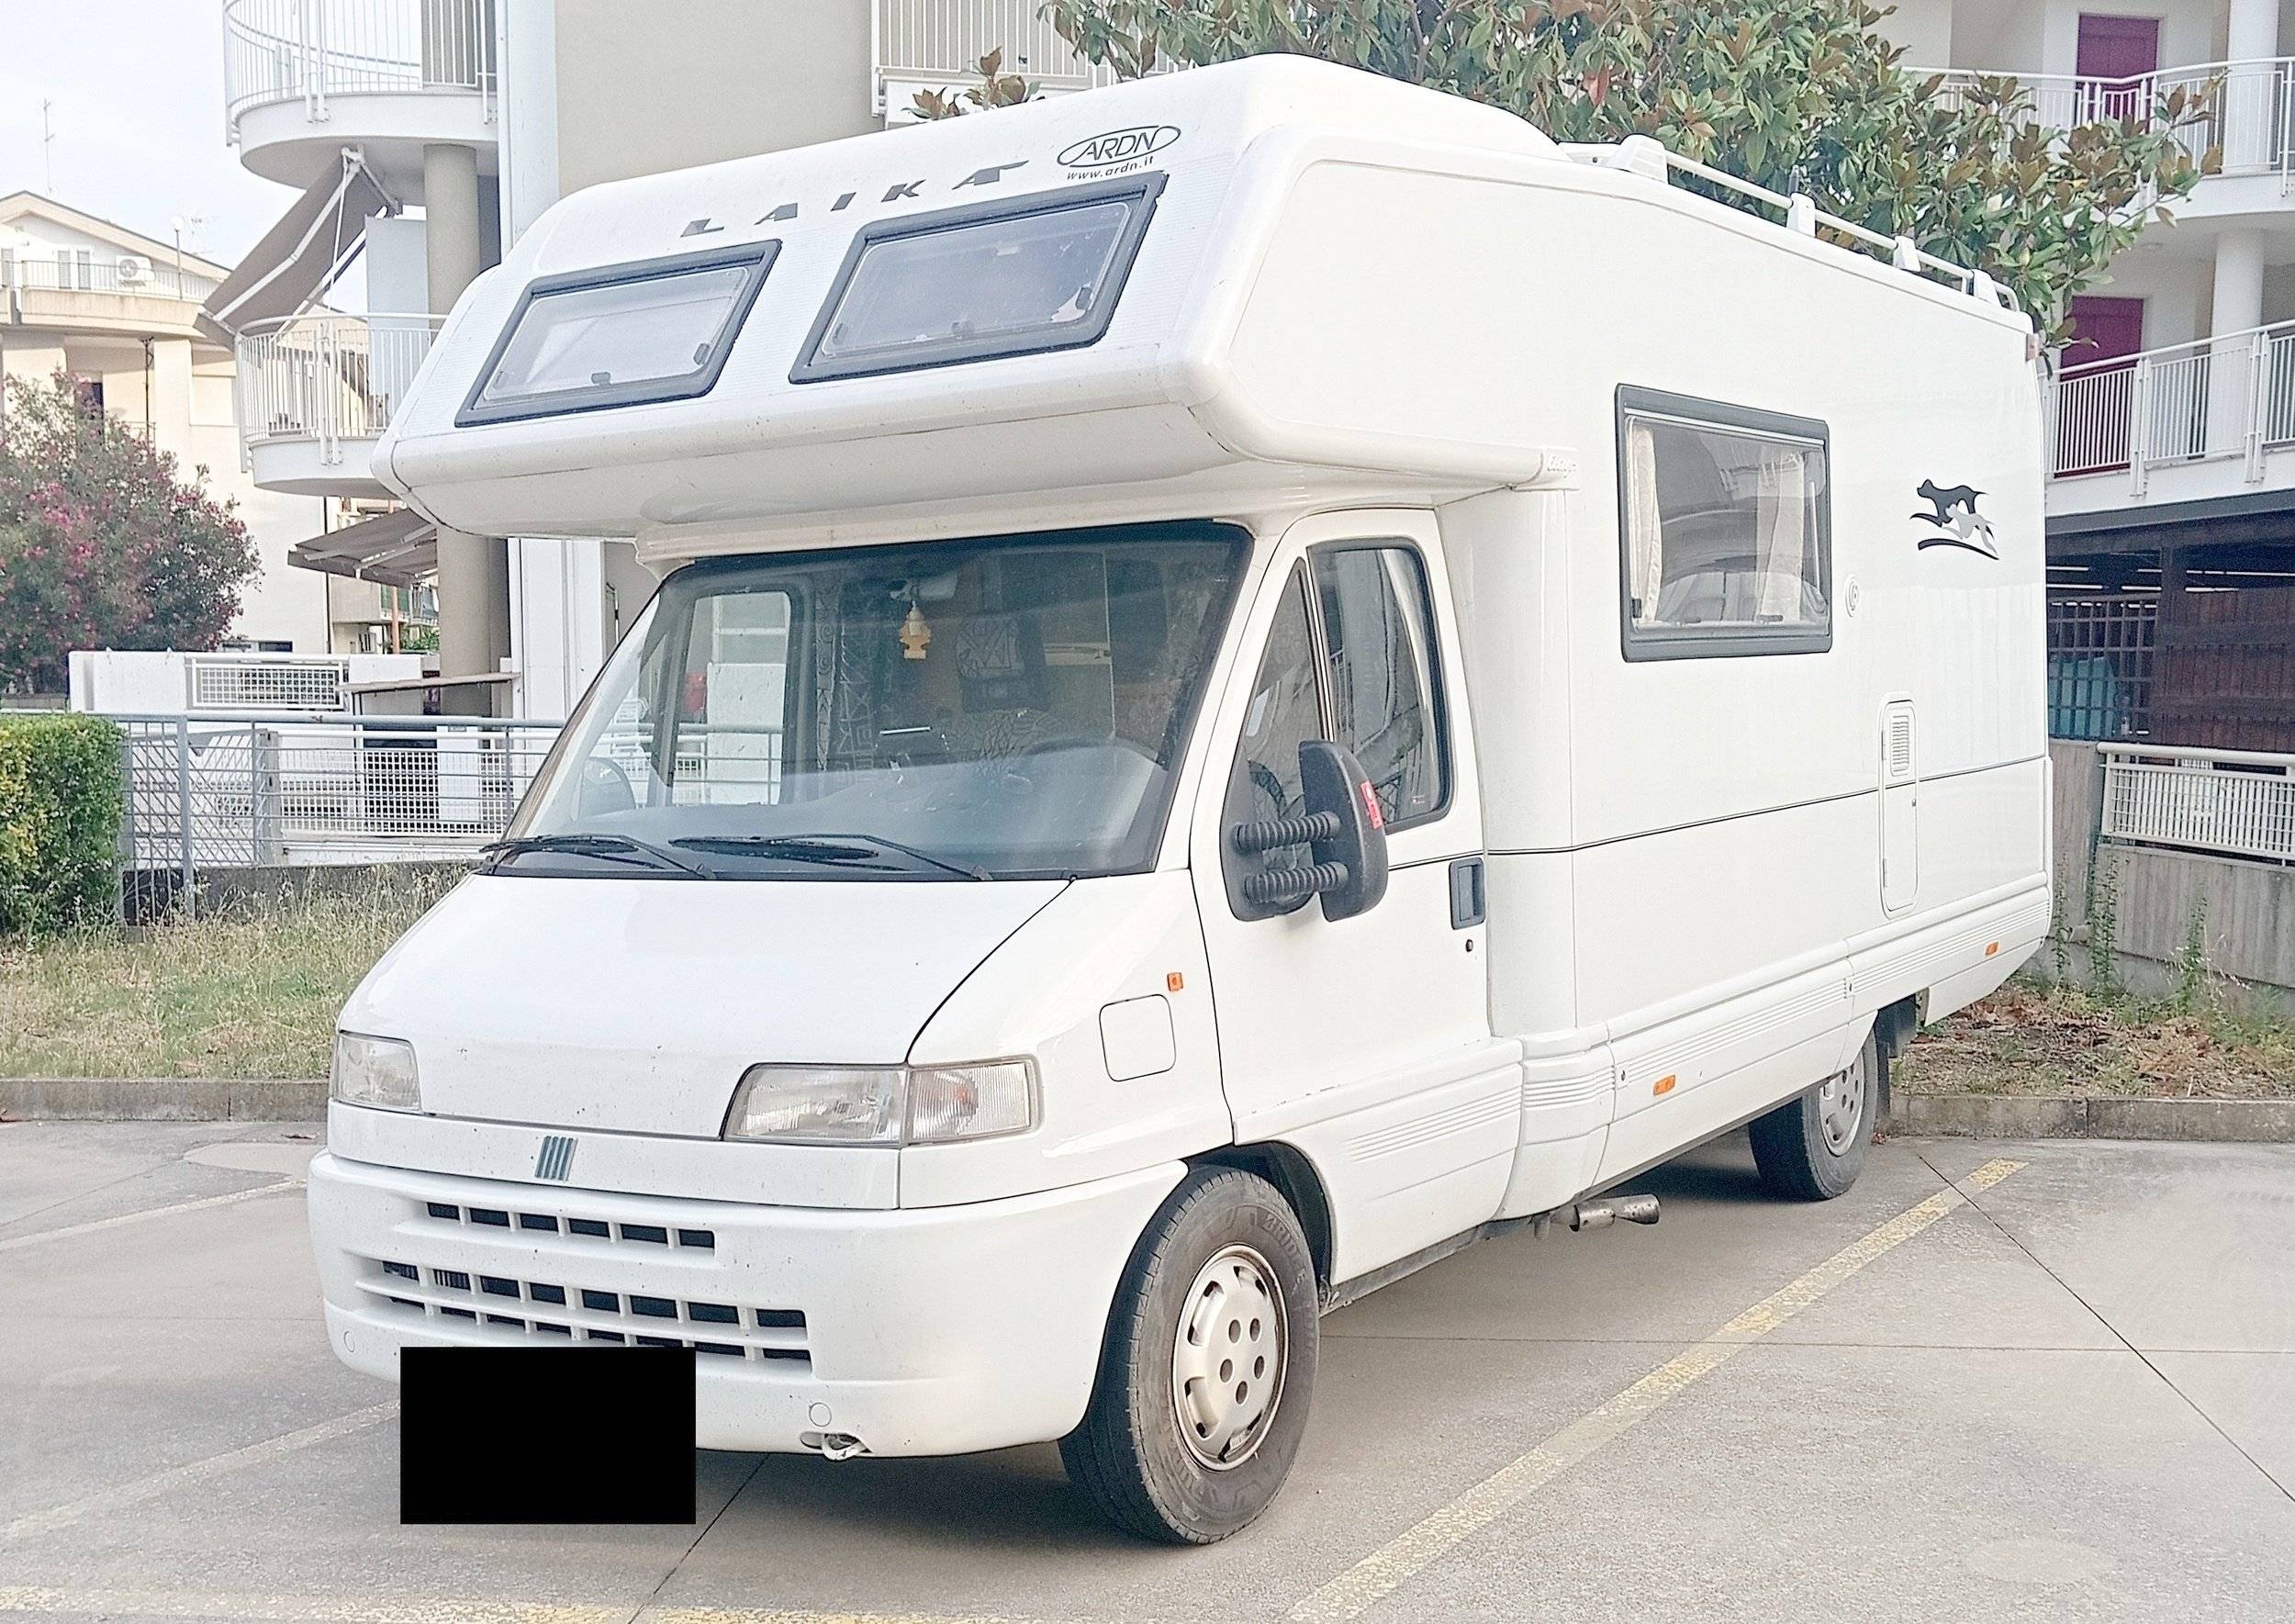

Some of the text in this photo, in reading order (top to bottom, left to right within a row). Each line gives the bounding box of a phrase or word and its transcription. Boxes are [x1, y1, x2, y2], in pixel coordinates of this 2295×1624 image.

[1080, 131, 1157, 161] ARDN
[1067, 155, 1154, 180] www.ardn.it
[680, 160, 1029, 238] LAIKA
